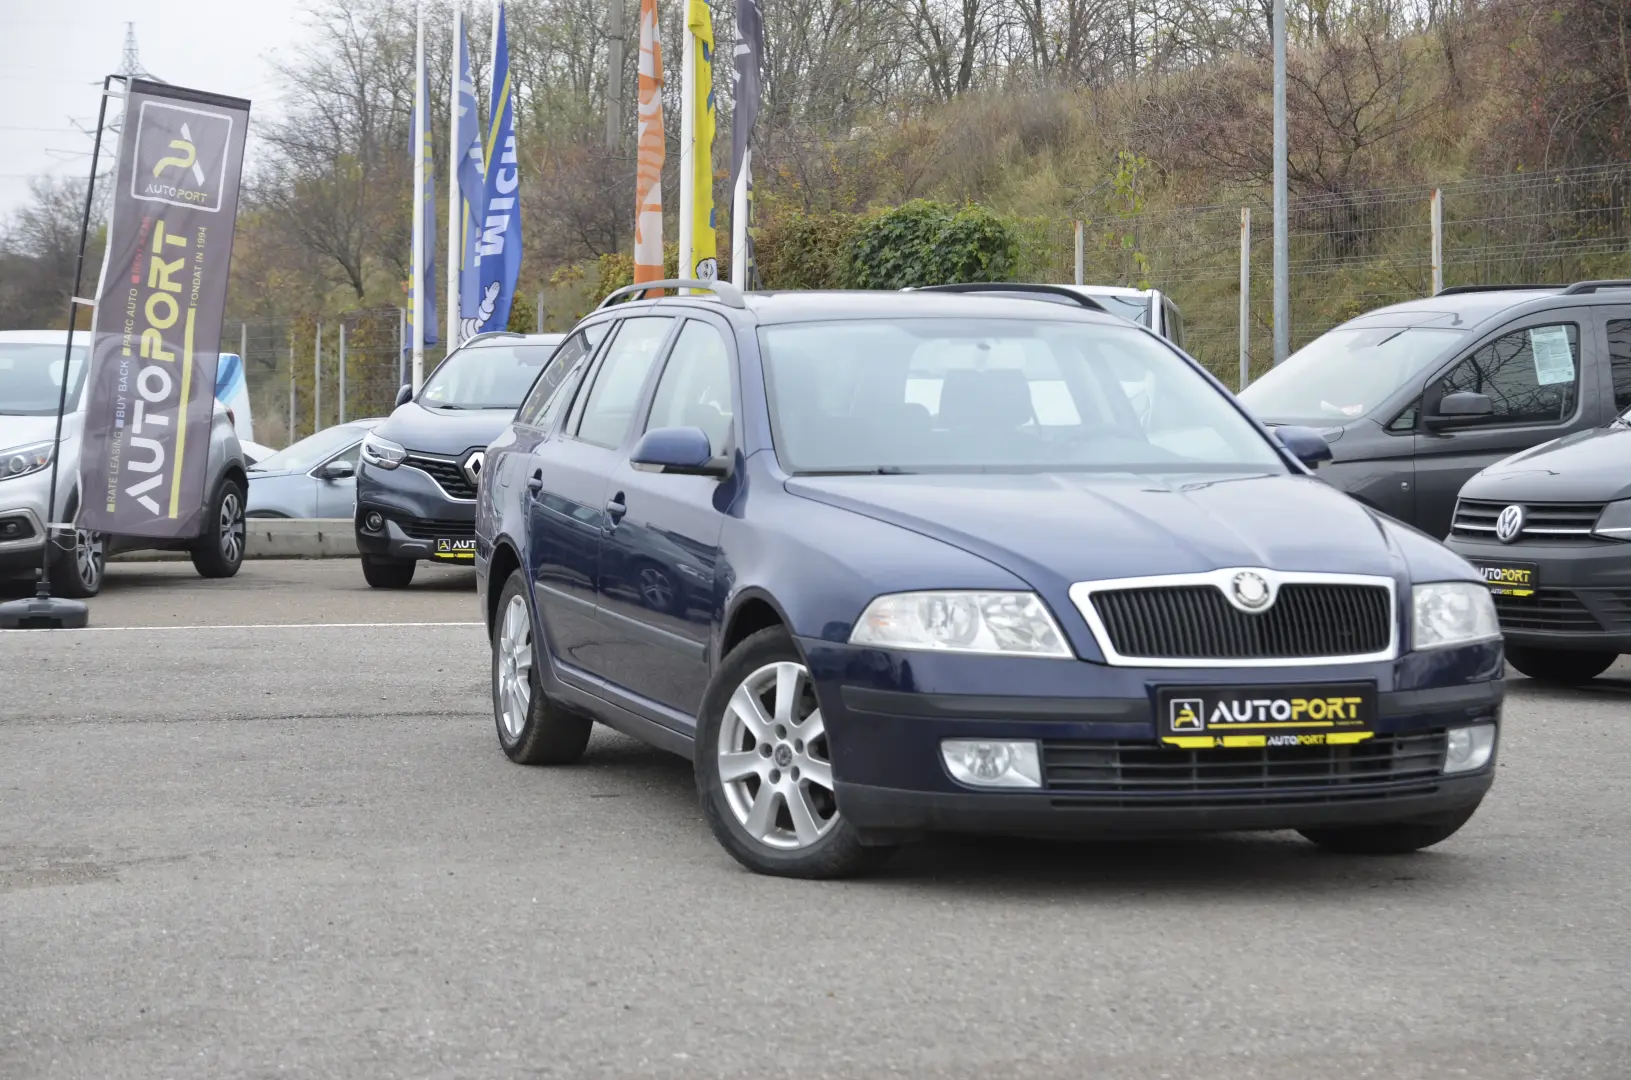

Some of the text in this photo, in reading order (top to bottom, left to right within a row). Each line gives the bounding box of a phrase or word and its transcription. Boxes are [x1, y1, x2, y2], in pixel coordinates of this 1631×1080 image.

[145, 183, 208, 203] AUTOPORT
[190, 226, 208, 306] FONDAT IN 1994
[127, 288, 138, 317] AUTO
[123, 317, 134, 348] PARC
[118, 360, 130, 392] BACK
[125, 220, 187, 516] AUTOPORT
[116, 395, 127, 418] BUY
[111, 431, 123, 475] LEASING
[107, 475, 118, 503] RATE
[1478, 567, 1531, 582] UTOPORT
[1210, 697, 1362, 722] AUTOPORT
[1267, 734, 1325, 746] AUTOPORT
